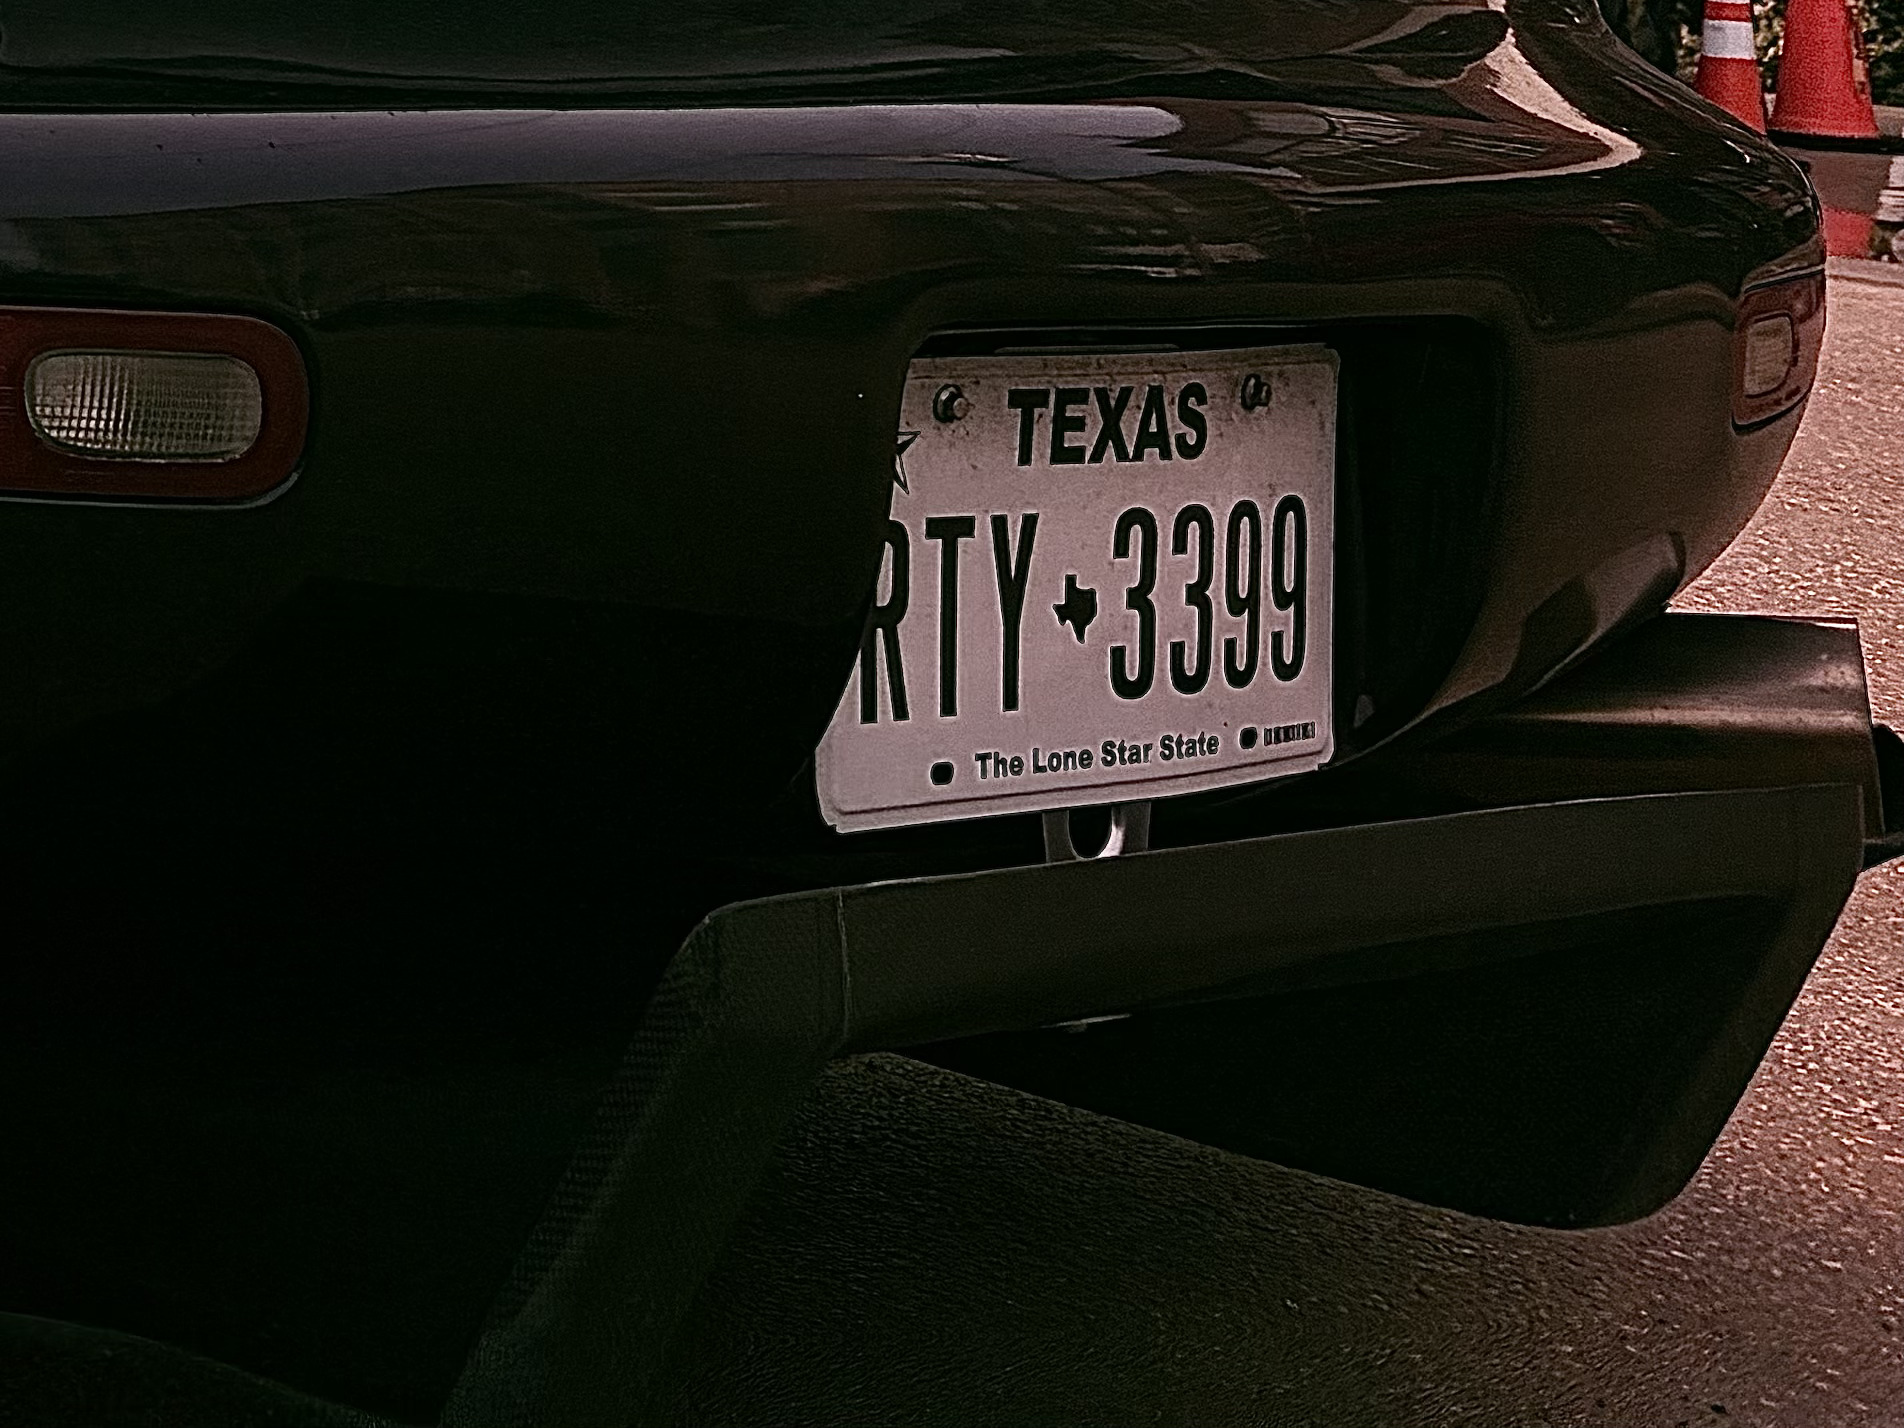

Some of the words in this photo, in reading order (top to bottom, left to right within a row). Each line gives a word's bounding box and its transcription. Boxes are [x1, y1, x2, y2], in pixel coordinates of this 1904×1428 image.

[1007, 382, 1209, 466] TEXAS
[859, 512, 1040, 724] RTY
[1109, 494, 1308, 700] 3399
[975, 751, 1023, 781] The
[1032, 745, 1093, 775] Lone
[1100, 739, 1153, 767] Star
[1159, 732, 1220, 763] State
